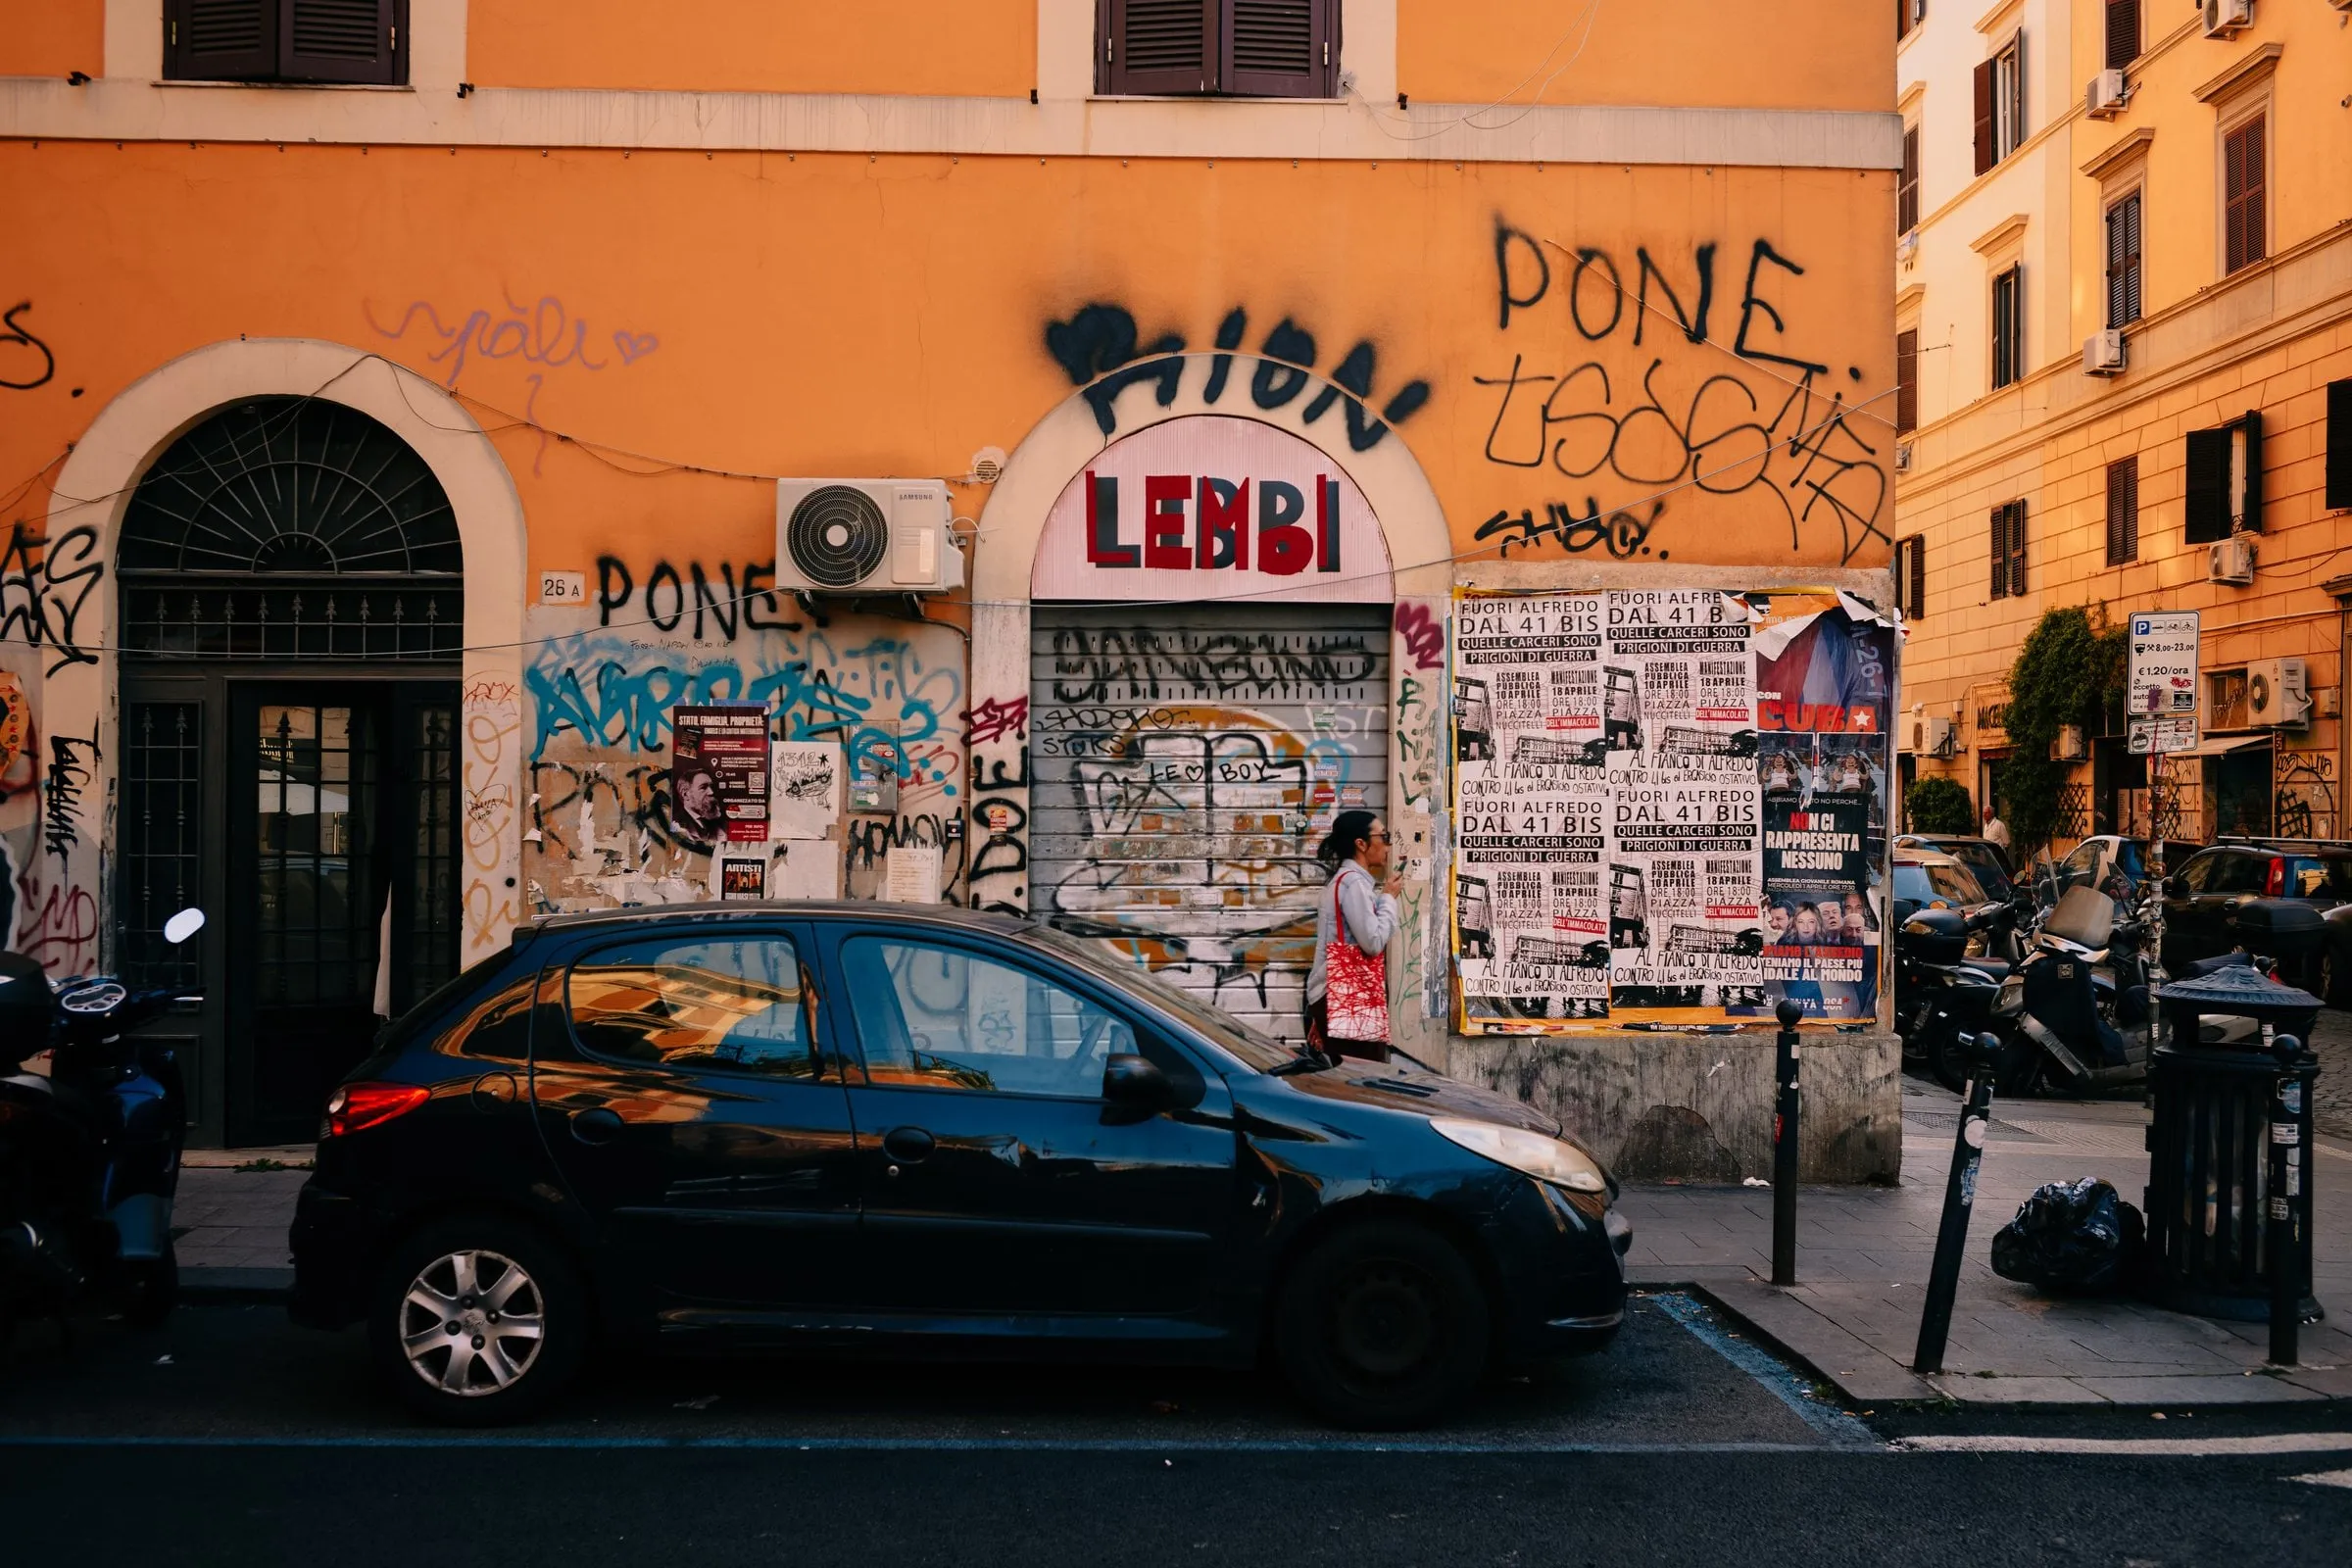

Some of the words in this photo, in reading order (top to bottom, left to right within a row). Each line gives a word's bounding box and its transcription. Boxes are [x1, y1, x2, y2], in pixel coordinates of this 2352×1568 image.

[545, 579, 564, 596] 26
[571, 585, 580, 596] A
[1610, 592, 1661, 605] FUORI
[1461, 603, 1512, 614] FUORI
[1520, 600, 1598, 613] ALFREDO
[1609, 608, 1658, 624] DAL
[1669, 607, 1694, 623] 41
[1460, 616, 1509, 634] DAL
[1520, 616, 1545, 633] 41
[1561, 614, 1598, 633] BIS
[1610, 627, 1655, 640] QUELLE
[1658, 627, 1709, 638] CARCERI
[1713, 626, 1746, 637] SONO
[1461, 637, 1506, 650] QUELLE
[1510, 636, 1560, 648] CARCERI
[1564, 635, 1597, 647] SONO
[1619, 643, 1673, 653] PRIGIONI
[1677, 643, 1689, 652] DI
[1692, 642, 1740, 653] GUERRA
[1470, 652, 1524, 663] PRIGIONI
[1528, 652, 1541, 662] DI
[1544, 651, 1592, 662] GUERRA
[1644, 662, 1688, 672] ASSEMBLEA
[2138, 667, 2144, 676] €
[1644, 680, 1654, 690] 10
[1656, 680, 1689, 689] APRILE
[1700, 678, 1711, 687] 18
[1712, 677, 1745, 686] APRILE
[1644, 690, 1661, 699] ORE
[1666, 689, 1689, 699] 18:00
[1700, 688, 1717, 698] ORE
[1722, 687, 1745, 697] 18:00
[1644, 700, 1690, 709] PIAZZA
[1700, 699, 1746, 708] PIAZZA
[1644, 710, 1690, 720] NUCCITELLI
[1695, 709, 1748, 720] DELL'IMMACOLATA
[1757, 702, 1878, 733] CUBA
[678, 715, 700, 725] STATO,
[700, 715, 729, 726] FAMIGLIA,
[1482, 760, 1498, 778] AL
[1504, 761, 1543, 778] FIANCO
[1548, 764, 1558, 778] DI
[1562, 764, 1606, 780] ALFREDO
[1617, 791, 1669, 802] FUORI
[1676, 790, 1754, 803] ALFREDO
[1464, 802, 1515, 813] FUORI
[1523, 802, 1602, 813] ALFREDO
[1617, 806, 1665, 822] DAL
[1676, 806, 1701, 822] 41
[1717, 805, 1754, 821] BIS
[1463, 816, 1511, 833] DAL
[1523, 816, 1548, 833] 41
[1564, 816, 1602, 833] BIS
[1789, 811, 1819, 831] NON
[1821, 813, 1835, 831] CI
[1617, 826, 1662, 837] QUELLE
[1666, 825, 1715, 836] CARCERI
[1719, 825, 1753, 836] SONO
[1463, 837, 1508, 848] QUELLE
[1512, 837, 1562, 848] CARCERI
[1566, 837, 1600, 848] SONO
[1627, 841, 1680, 852] PRIGIONI
[1684, 841, 1696, 851] DI
[1699, 841, 1746, 851] GUERRA
[1766, 831, 1860, 852] RAPPRESENTA
[1472, 852, 1526, 862] PRIGIONI
[1530, 852, 1543, 862] DI
[1546, 852, 1594, 862] GUERRA
[1782, 851, 1842, 870] NESSUNO
[1651, 860, 1694, 870] ASSEMBLEA
[1663, 878, 1695, 887] APRILE
[1707, 876, 1717, 885] 18
[1718, 876, 1751, 885] APRILE
[1650, 888, 1667, 897] ORE
[1673, 887, 1695, 897] 18:00
[1706, 887, 1724, 896] ORE
[1728, 886, 1751, 896] 18:00
[1650, 898, 1696, 907] PIAZZA
[1706, 897, 1751, 906] PIAZZA
[1649, 908, 1697, 918] NUCCITELLI
[1705, 906, 1758, 917] DELL'IMMACOLATA
[1804, 947, 1864, 956] L'ASSEDIO
[1635, 948, 1651, 966] AL
[1657, 951, 1695, 967] FIANCO
[1701, 955, 1709, 968] DI
[1715, 953, 1758, 970] ALFREDO
[1762, 958, 1801, 968] TENIAMO
[1803, 958, 1813, 968] IL
[1815, 958, 1845, 968] PAESE
[1615, 967, 1653, 984] CONTRO
[1725, 972, 1761, 984] OSTATIVO
[1764, 968, 1799, 980] IDALE
[1802, 968, 1819, 980] AL
[1821, 969, 1862, 982] MONDO
